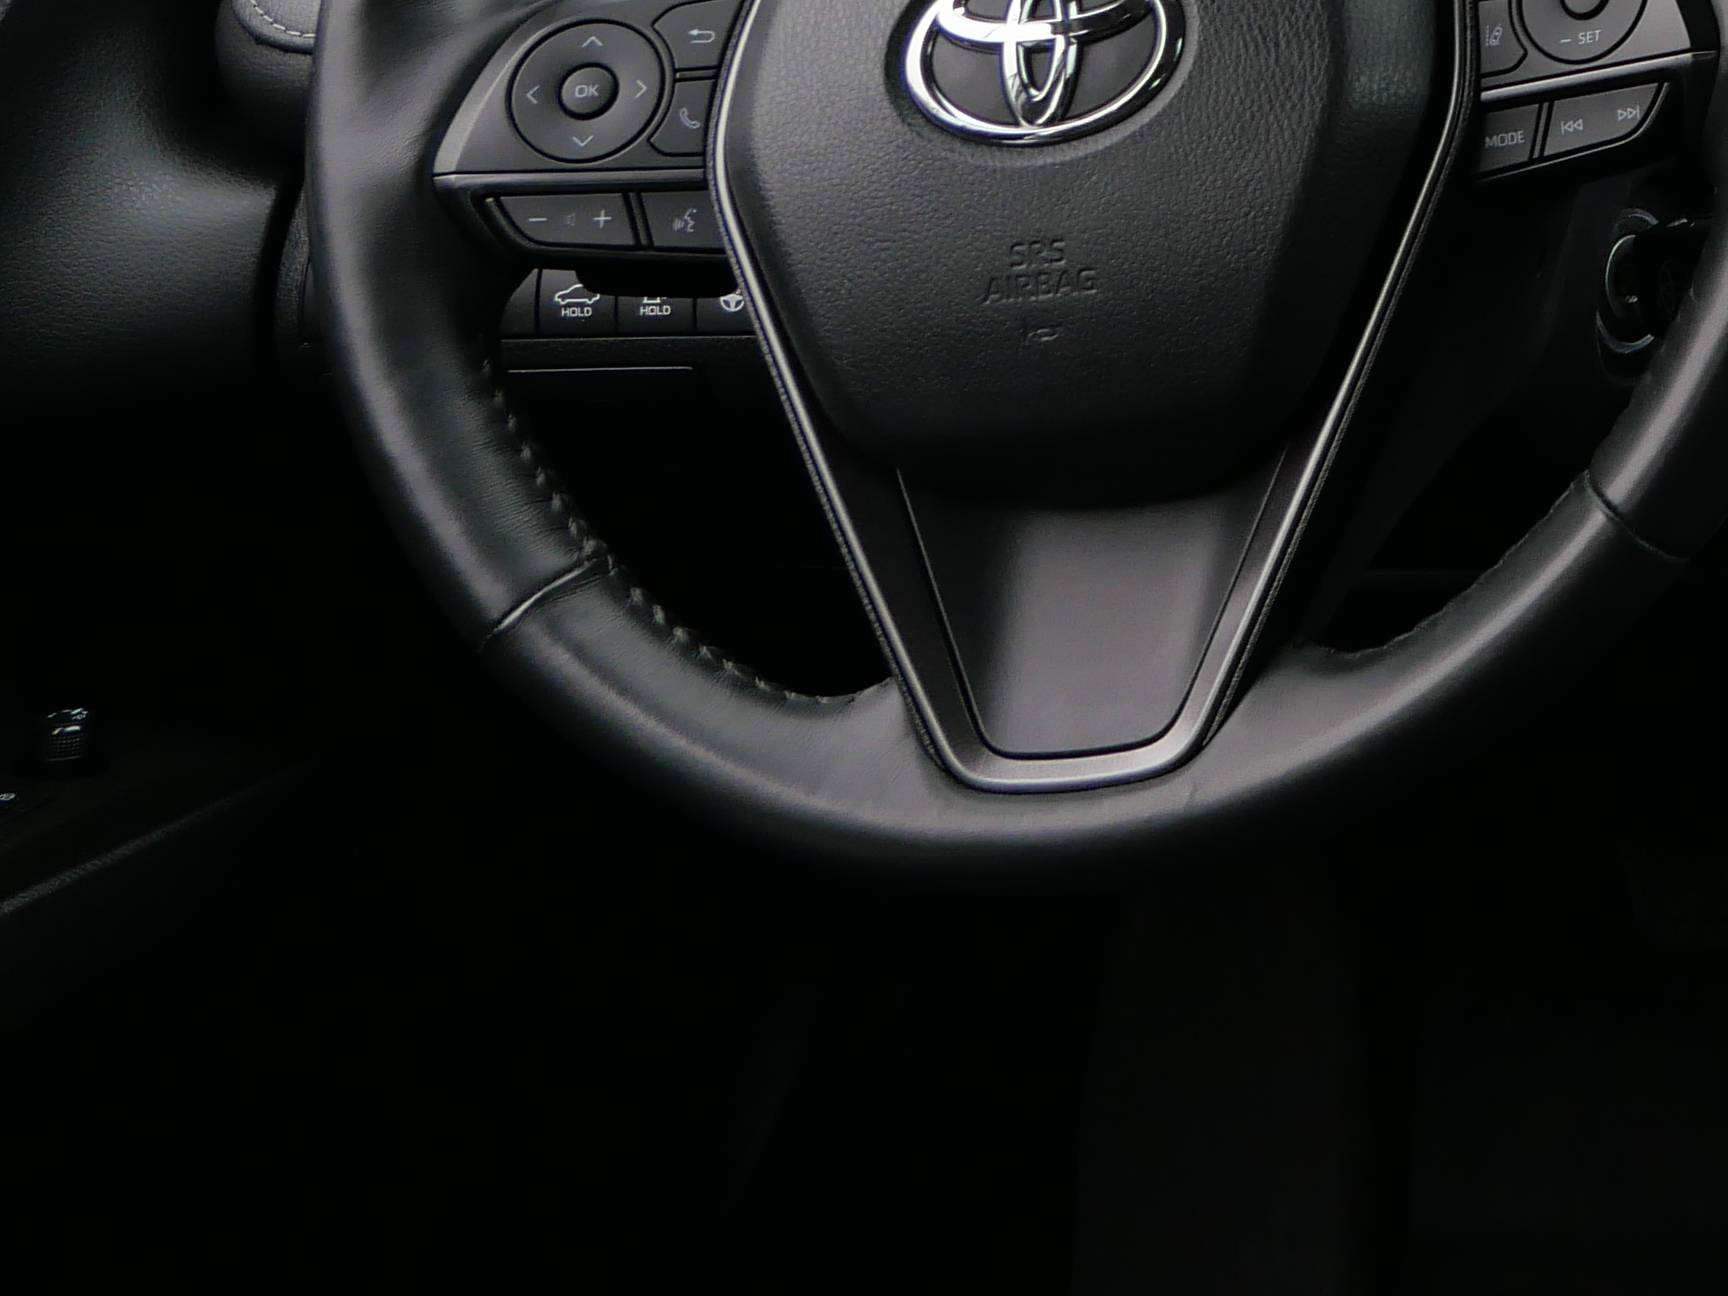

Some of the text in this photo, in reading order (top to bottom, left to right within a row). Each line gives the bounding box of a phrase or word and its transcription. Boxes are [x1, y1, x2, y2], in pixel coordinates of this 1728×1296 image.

[1577, 29, 1602, 44] SET
[573, 83, 600, 98] OK
[1484, 129, 1526, 148] MODE
[1008, 239, 1067, 268] SRS
[980, 268, 1099, 304] AIRBAG
[561, 305, 672, 317] HOLD HOLD
